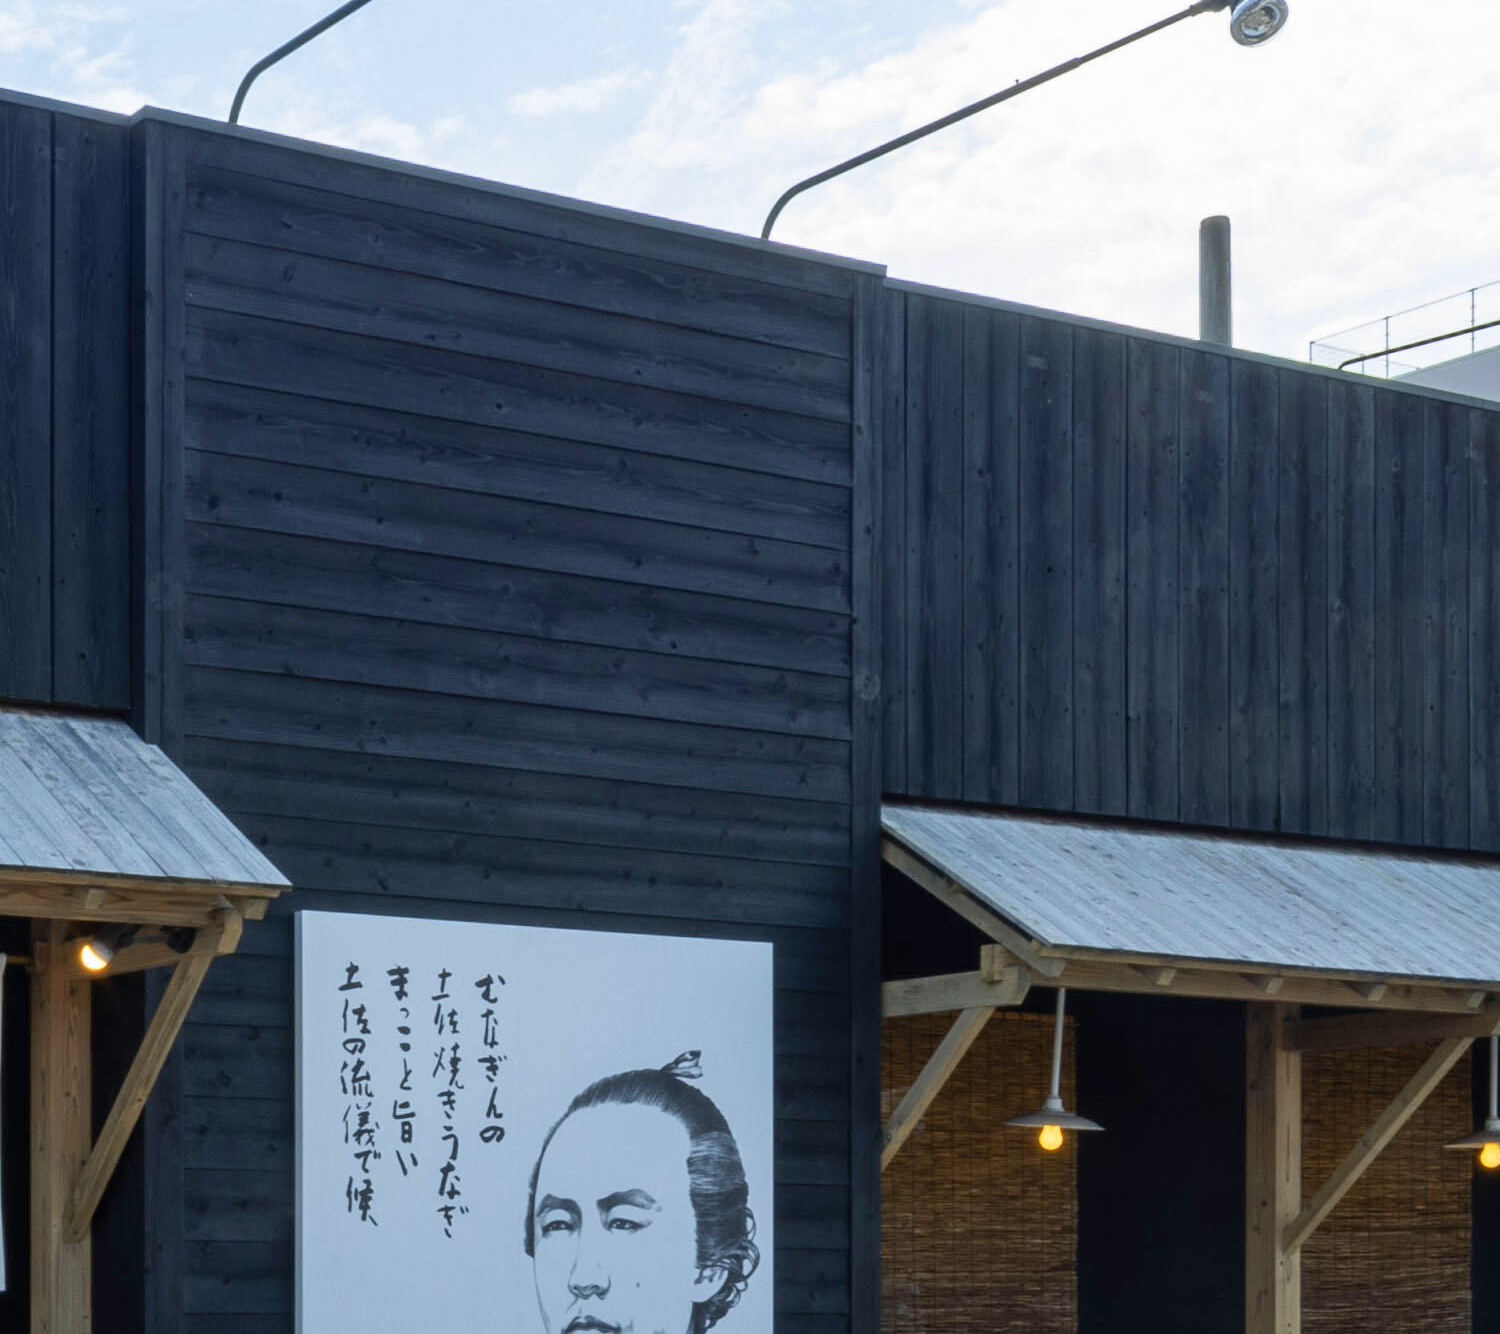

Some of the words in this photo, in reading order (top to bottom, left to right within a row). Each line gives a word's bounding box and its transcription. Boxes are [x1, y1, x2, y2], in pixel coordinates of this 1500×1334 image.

[386, 964, 419, 1177] まっこと旨い
[431, 968, 470, 1239] 土佐焼きうなぎ
[474, 973, 508, 1144] むなぎんの
